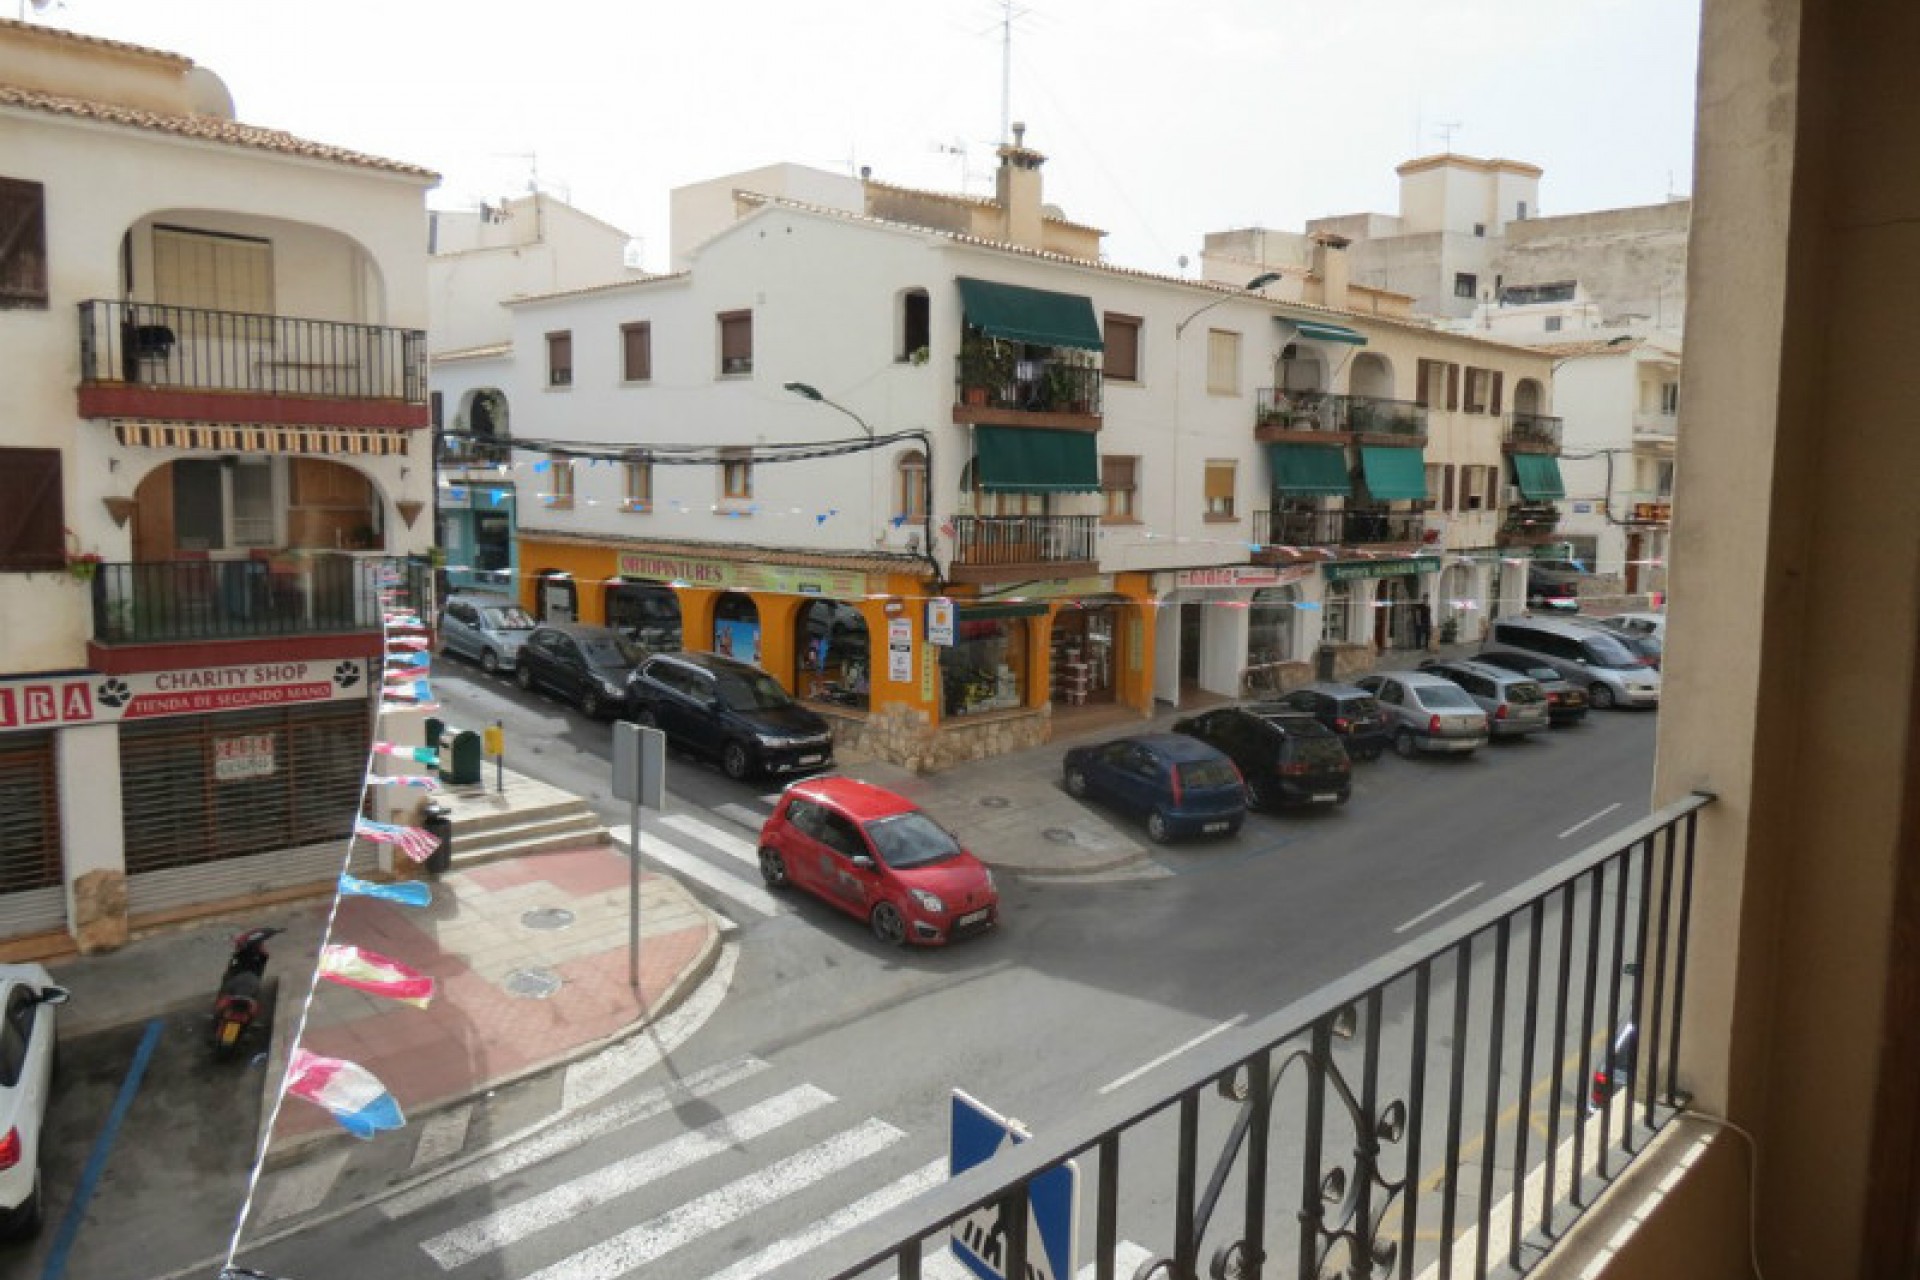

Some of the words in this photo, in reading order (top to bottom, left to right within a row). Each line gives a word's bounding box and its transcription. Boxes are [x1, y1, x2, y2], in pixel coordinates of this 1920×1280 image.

[155, 668, 247, 691] CHARITY
[254, 663, 308, 682] SHOP
[135, 696, 190, 713] TIENDA
[193, 694, 212, 708] DE
